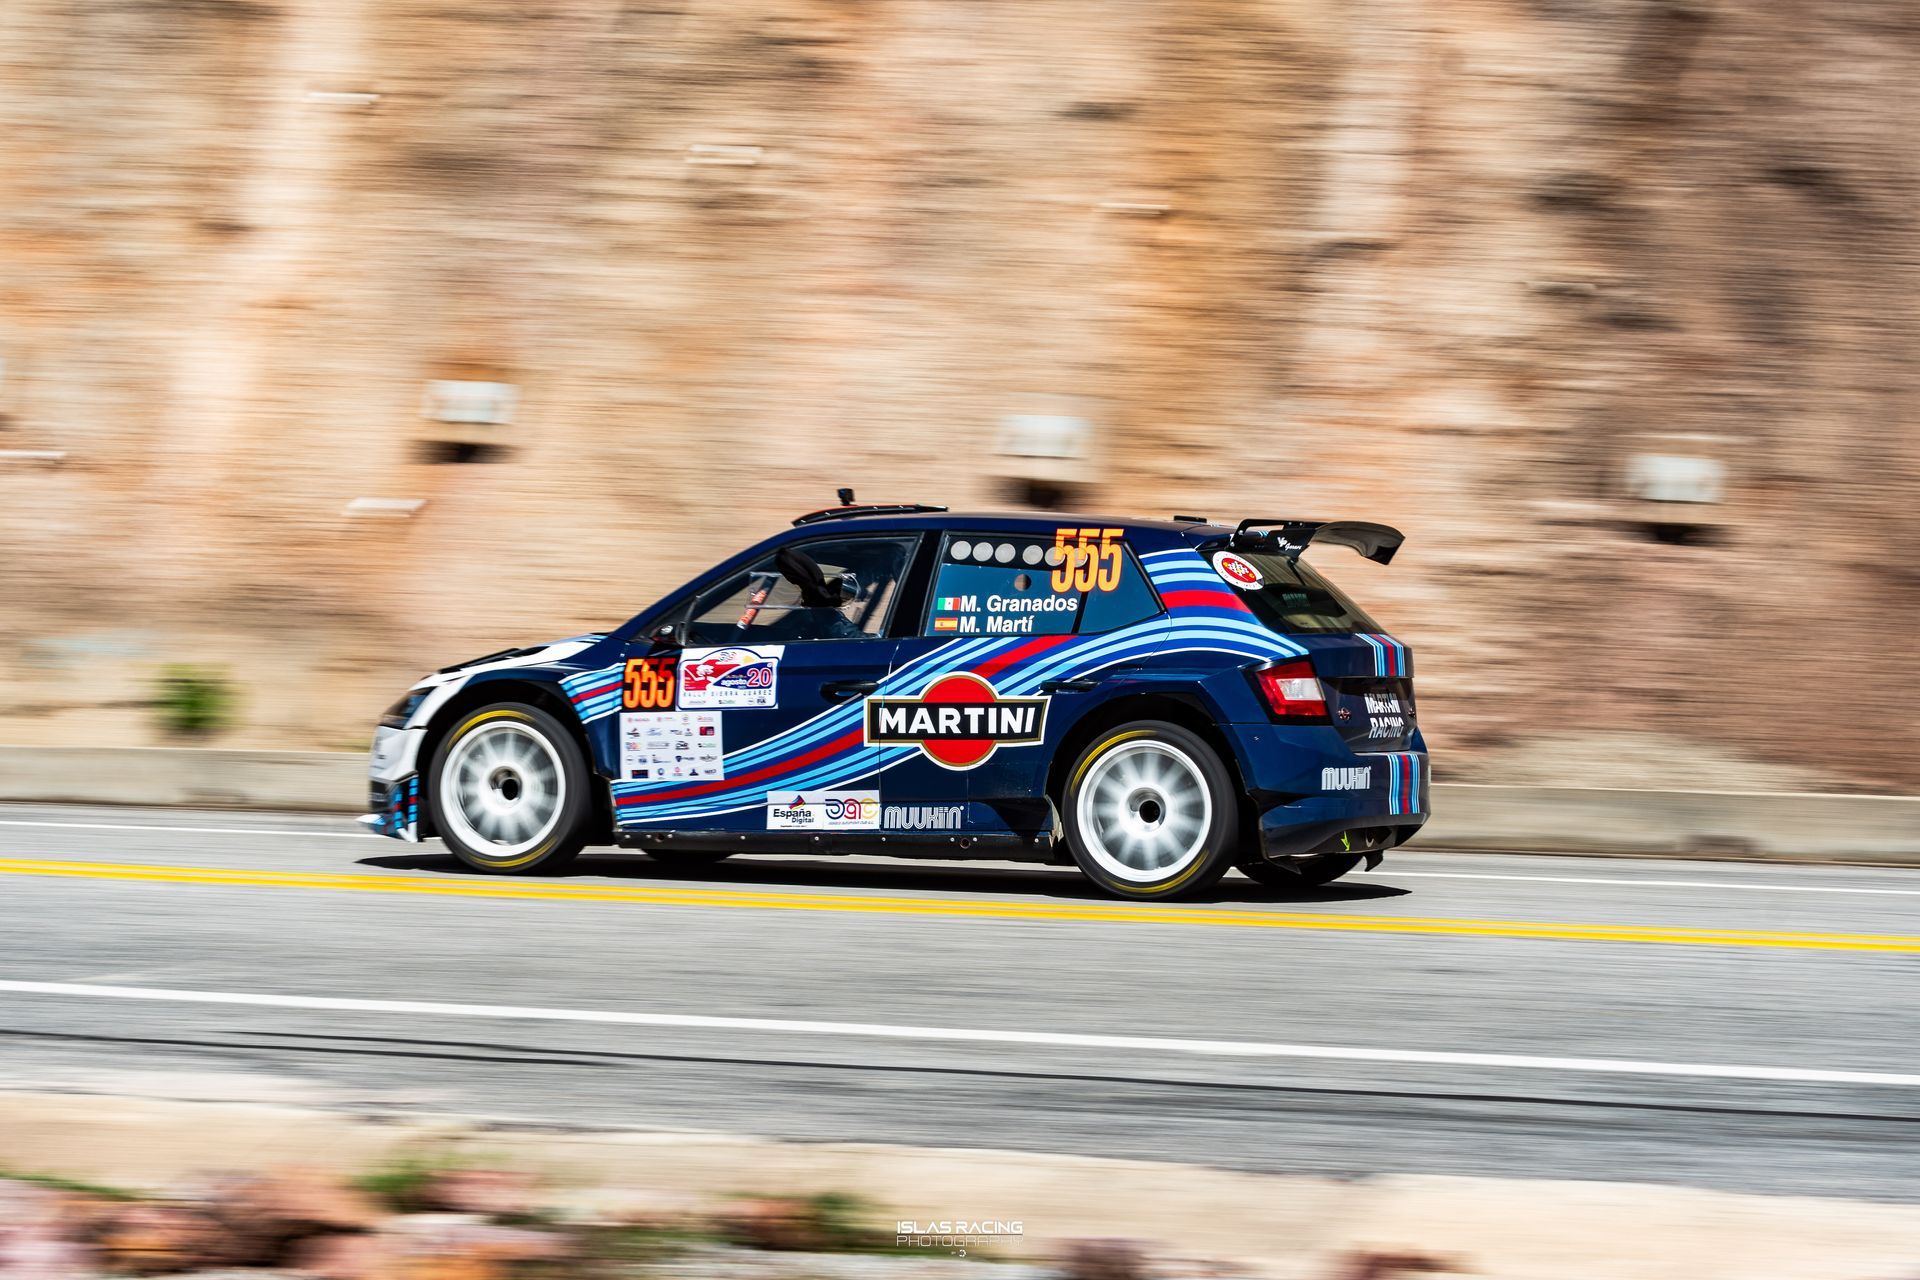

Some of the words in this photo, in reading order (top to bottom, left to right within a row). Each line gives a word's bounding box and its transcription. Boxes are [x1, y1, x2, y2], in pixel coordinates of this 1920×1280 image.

[1051, 528, 1124, 593] 555
[960, 595, 981, 612] M.
[986, 594, 1078, 612] Granados
[959, 616, 980, 633] M.
[986, 615, 1035, 633] Martí
[623, 658, 676, 709] 555
[746, 667, 773, 687] 20
[879, 707, 1036, 734] MARTINI
[1368, 716, 1404, 739] RACING
[773, 808, 812, 819] España
